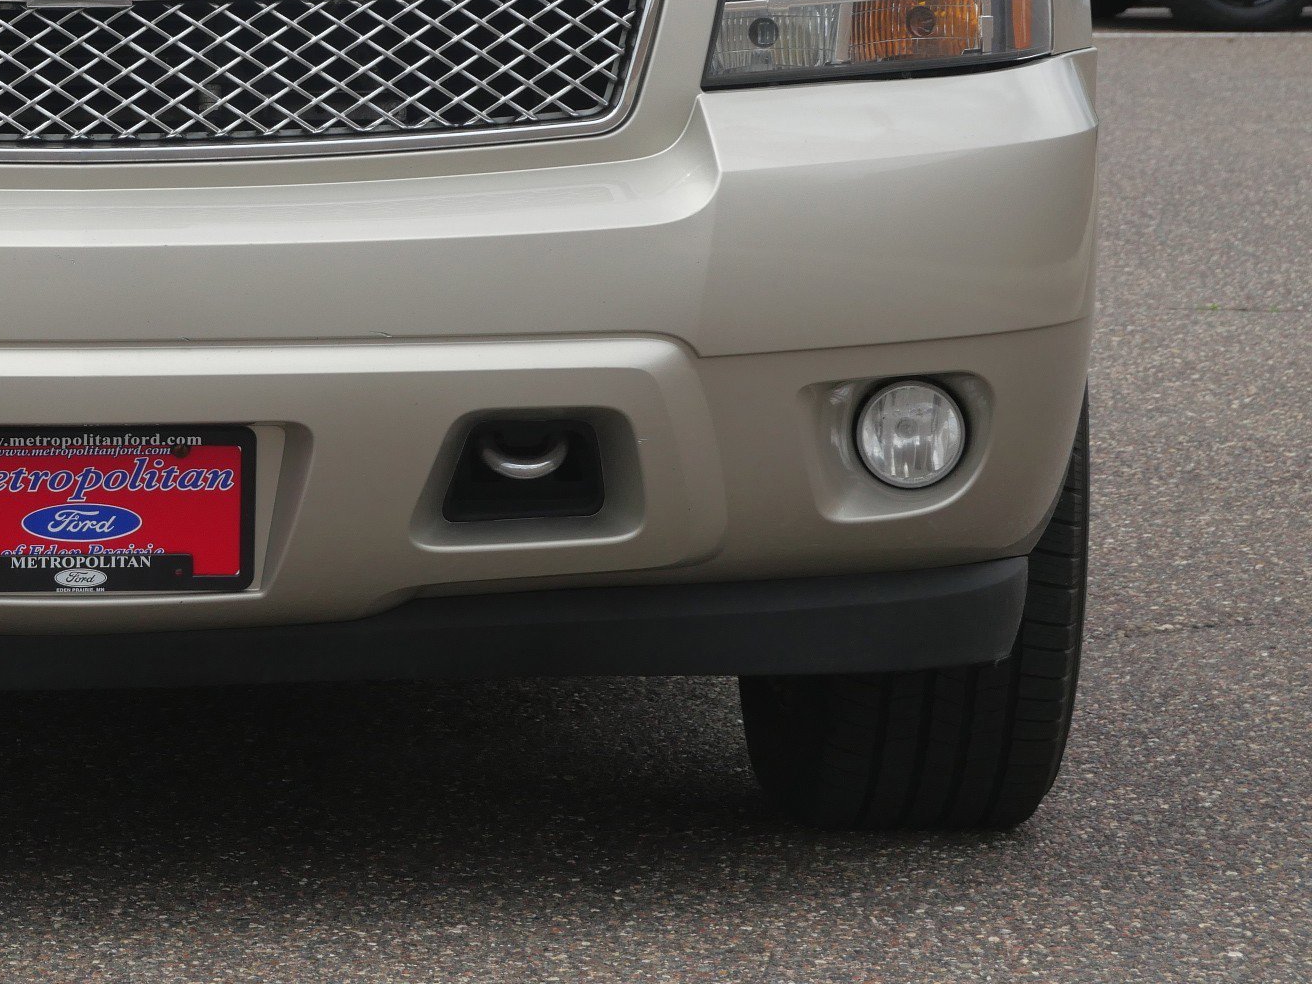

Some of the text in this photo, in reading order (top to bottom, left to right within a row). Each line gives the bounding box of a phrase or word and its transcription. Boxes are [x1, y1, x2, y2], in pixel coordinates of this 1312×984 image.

[47, 509, 116, 534] Ford
[11, 556, 151, 568] METROPOLITAN
[66, 571, 96, 583] Ford
